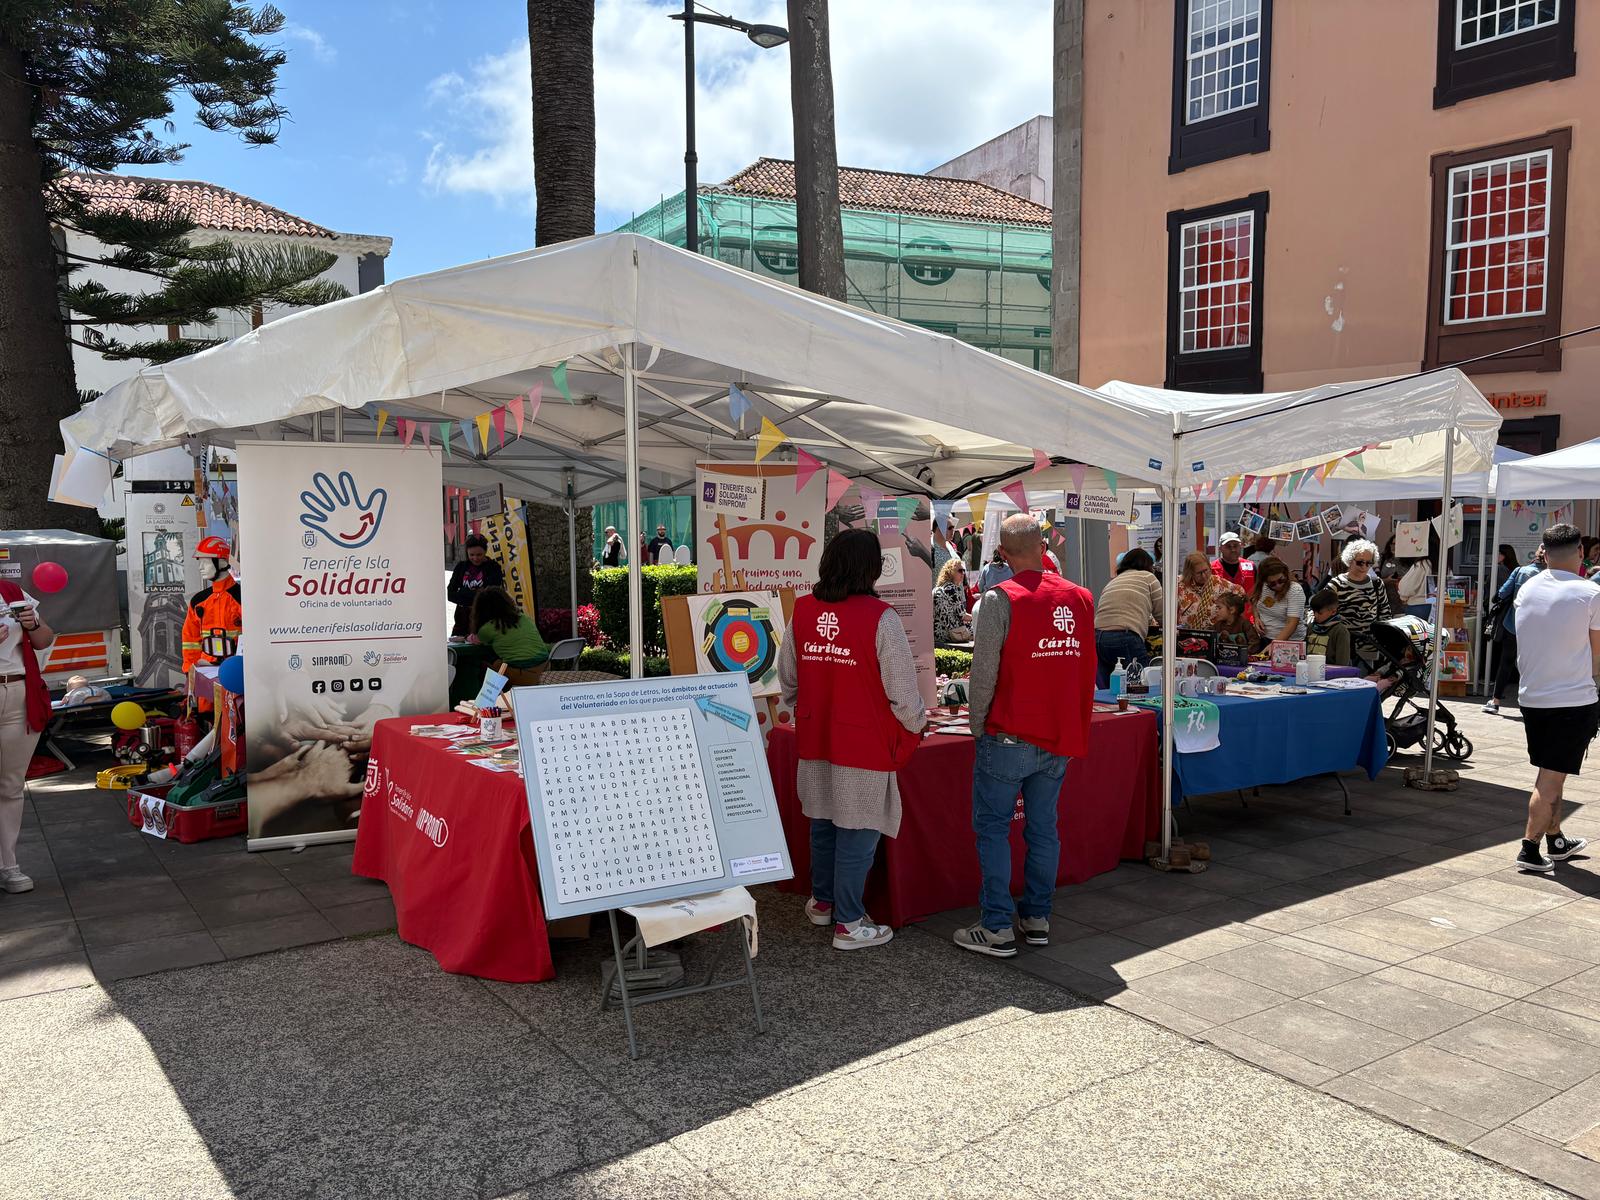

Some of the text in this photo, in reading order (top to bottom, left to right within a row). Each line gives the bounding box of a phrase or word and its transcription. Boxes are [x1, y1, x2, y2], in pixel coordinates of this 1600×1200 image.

[704, 487, 715, 498] 49
[719, 482, 757, 494] TENERIFE ISLA
[719, 490, 748, 500] SOLIDARIA
[1068, 497, 1079, 506] 48
[1104, 508, 1126, 517] MAYOR
[302, 556, 390, 572] Tenerife Isla
[782, 569, 803, 577] una
[285, 572, 407, 597] Solidaria
[299, 599, 393, 608] Oficina de voluntariado
[269, 621, 423, 635] www.tenerifeislasolidaria.org
[804, 641, 851, 656] Cáritas
[559, 694, 595, 703] Encuentra,
[613, 690, 630, 700] Sopa
[640, 688, 660, 697] Letras,
[661, 686, 670, 694] los
[671, 684, 698, 694] ámbitos
[698, 683, 706, 691] de
[707, 681, 738, 691] actuación
[572, 699, 619, 709] Voluntariado
[628, 697, 639, 705] los
[639, 697, 651, 706] que
[652, 694, 675, 704] puedes
